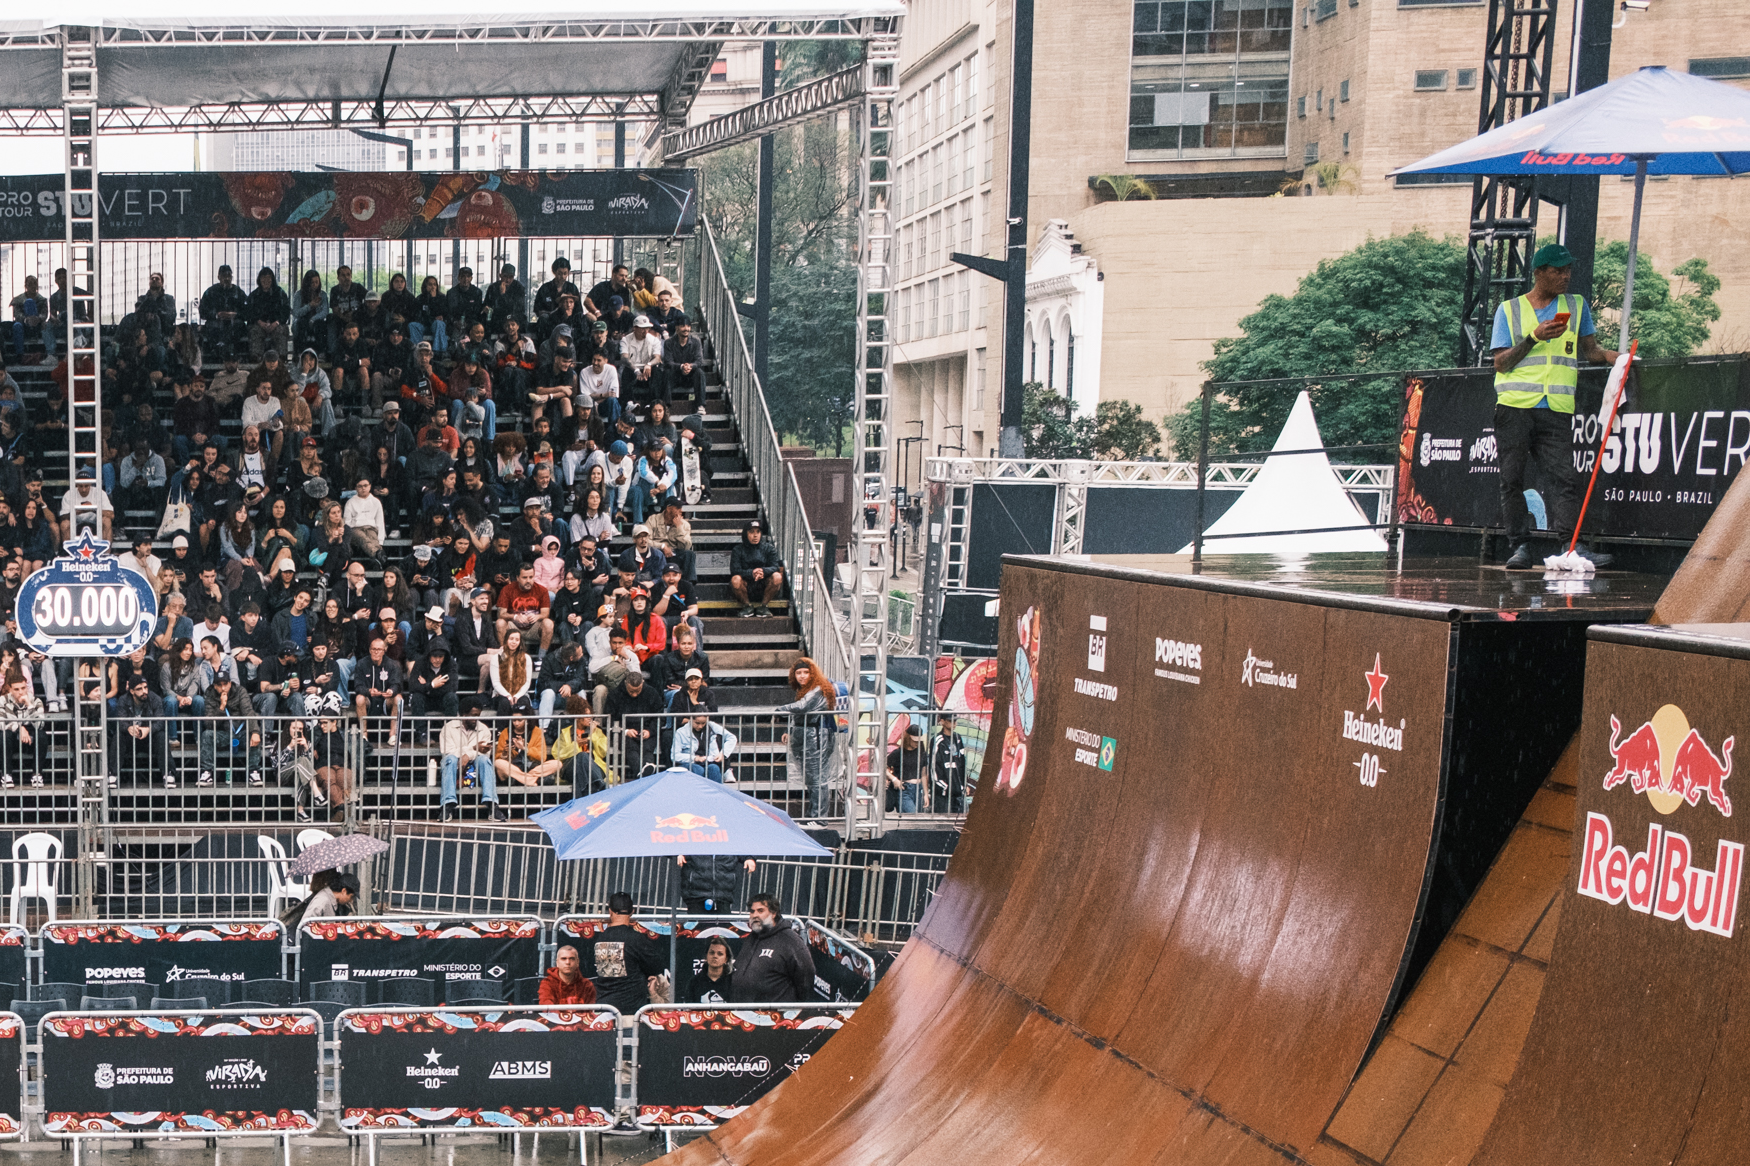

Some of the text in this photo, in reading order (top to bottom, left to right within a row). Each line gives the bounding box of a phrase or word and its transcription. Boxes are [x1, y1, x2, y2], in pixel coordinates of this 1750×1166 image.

[98, 188, 192, 216] VERT
[556, 203, 595, 212] SÃO PAULO
[1571, 413, 1598, 444] RO
[1431, 438, 1463, 448] PREFEITURA DE
[1431, 448, 1462, 461] SÃO PAULO
[1604, 487, 1713, 504] SÃO PAULO BRAZIL
[61, 561, 111, 572] Heineken
[35, 586, 137, 628] 30.000
[1255, 668, 1297, 690] Cruzeiro do Sul
[1074, 677, 1118, 702] TRANSPETRO
[1065, 726, 1101, 749] MINISTÉRIO DO
[1342, 709, 1403, 752] Heineken
[1074, 748, 1099, 768] ESPORTE
[1358, 752, 1380, 788] 0.0
[650, 829, 729, 844] Red Bull
[1577, 811, 1745, 938] Red Bull
[352, 969, 418, 977] TRANSPETRO
[423, 962, 468, 972] MINISTÉRIO
[219, 972, 231, 981] do
[231, 972, 245, 981] Sul
[445, 972, 482, 980] ESPORTE
[116, 1067, 174, 1075] PREFEITURA DE
[406, 1066, 459, 1077] Heineken
[491, 1061, 551, 1077] ABMS
[116, 1074, 174, 1084] SÃO PAULO
[424, 1077, 441, 1089] 0.0
